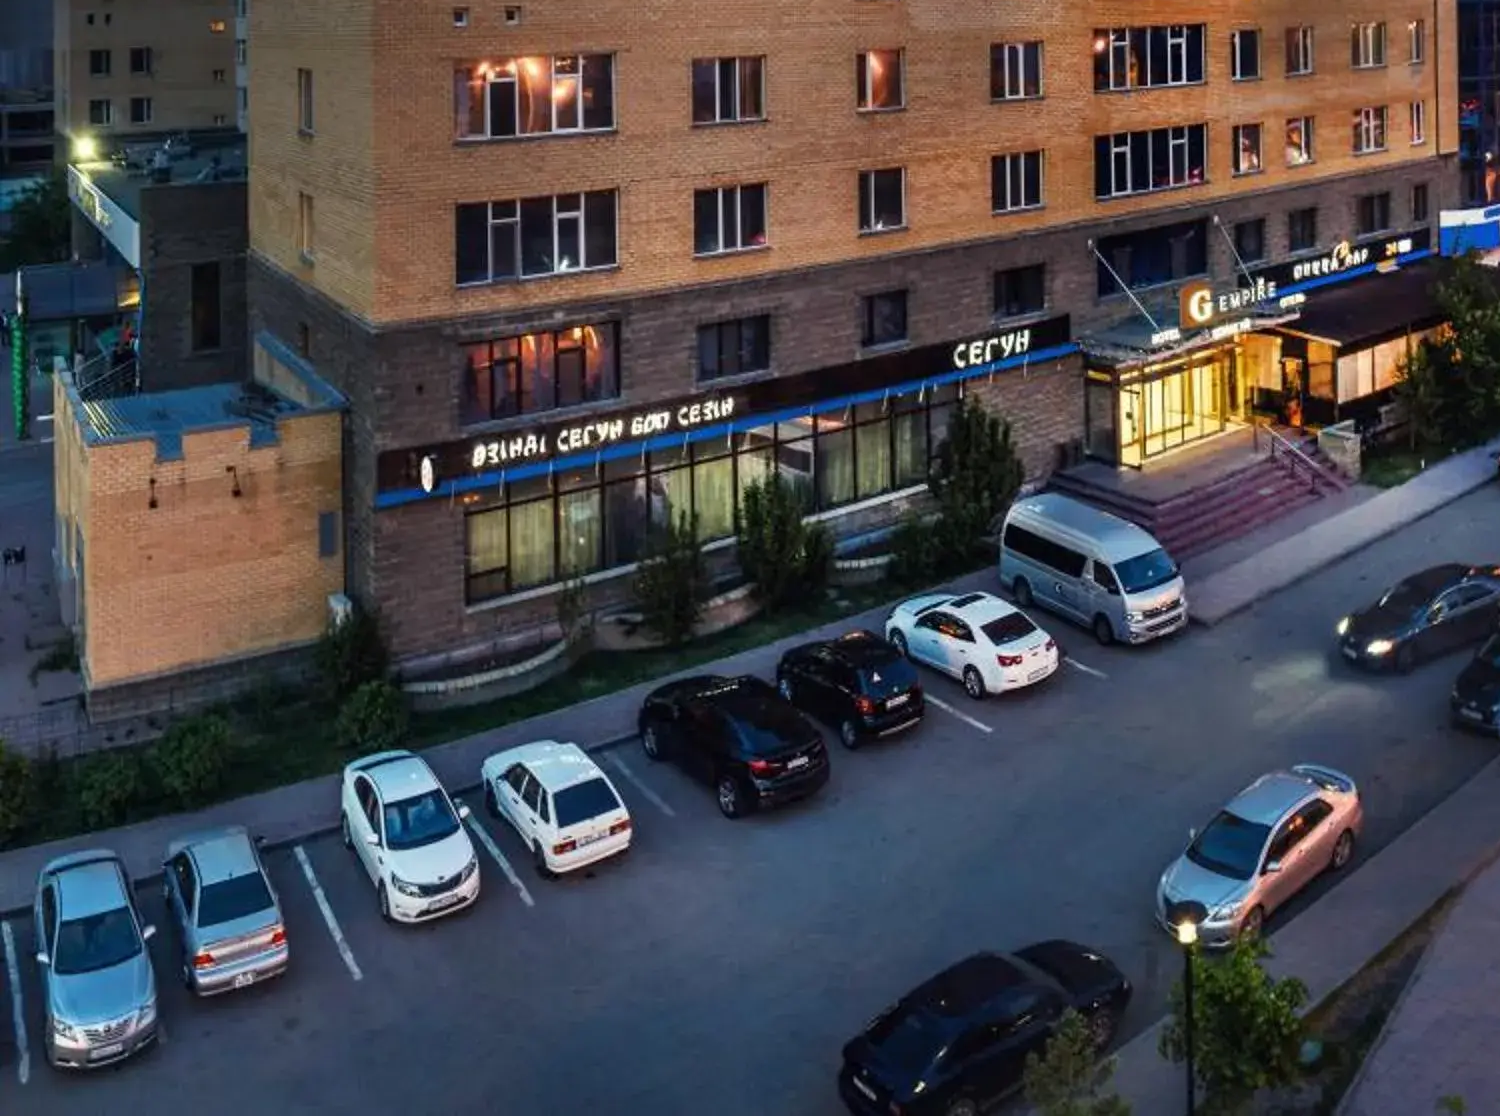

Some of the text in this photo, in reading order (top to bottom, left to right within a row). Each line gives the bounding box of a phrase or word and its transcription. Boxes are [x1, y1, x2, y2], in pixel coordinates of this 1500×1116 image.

[1189, 289, 1214, 323] G
[1218, 280, 1277, 313] EMPIRE
[953, 329, 1031, 369] СЕГУН
[557, 419, 624, 452] СЕГУН
